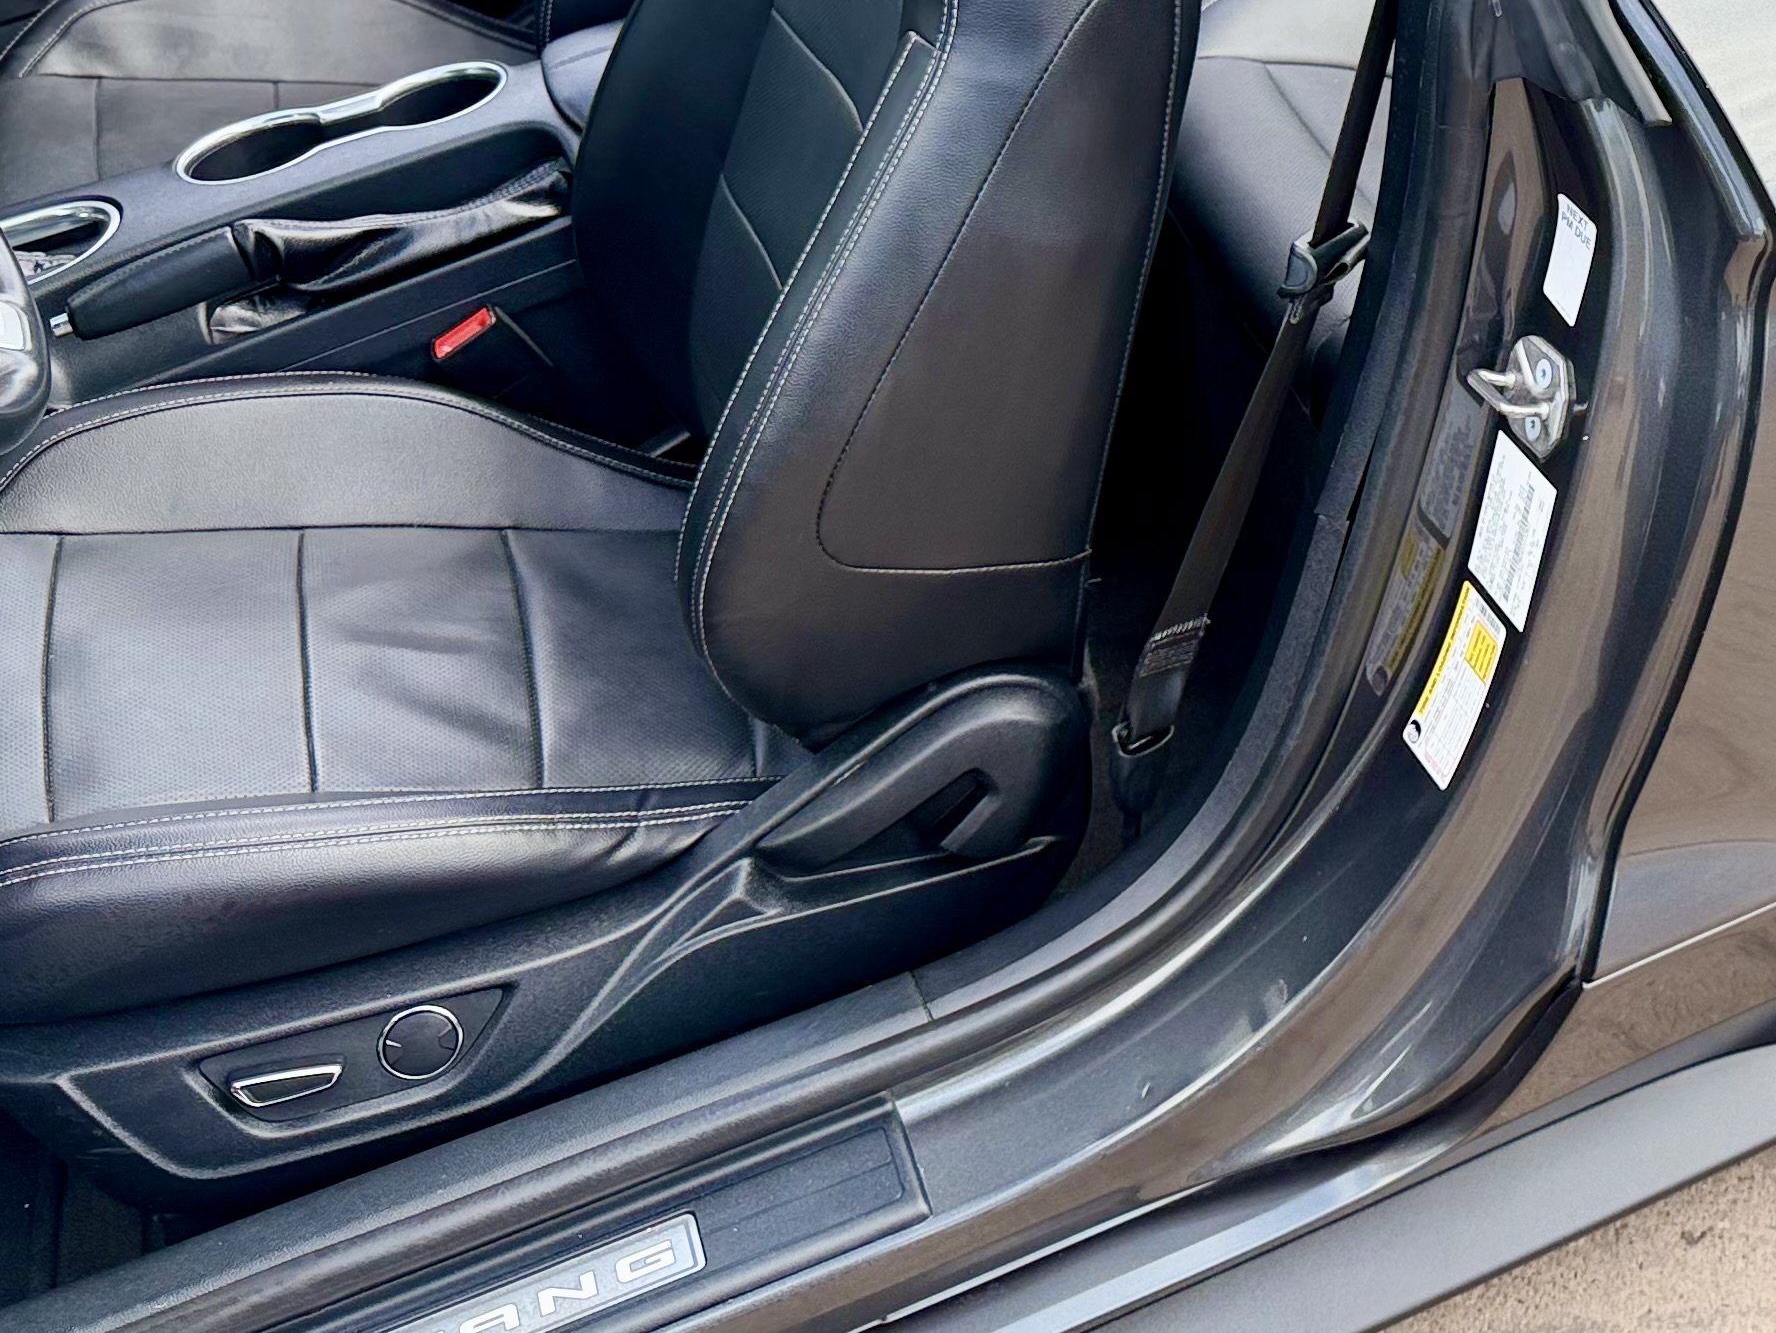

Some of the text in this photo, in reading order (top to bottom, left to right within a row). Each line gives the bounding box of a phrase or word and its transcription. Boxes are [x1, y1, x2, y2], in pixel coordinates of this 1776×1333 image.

[1566, 203, 1589, 230] NEXT
[1574, 224, 1592, 250] DUE
[436, 1239, 677, 1333] ANG
